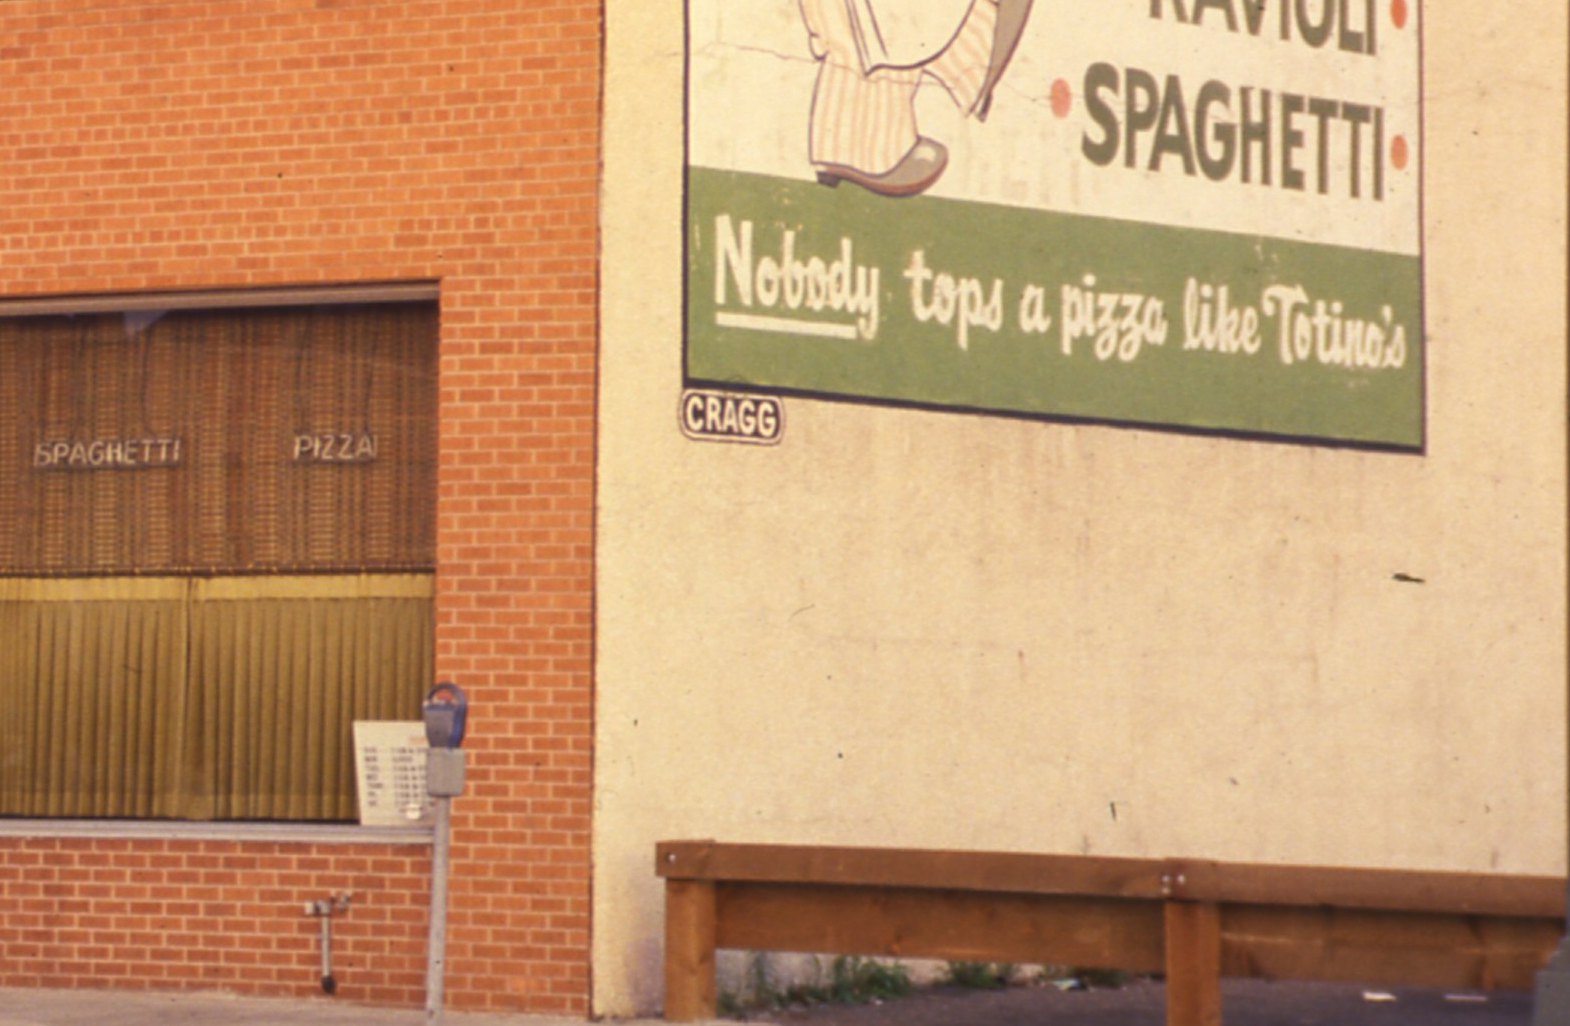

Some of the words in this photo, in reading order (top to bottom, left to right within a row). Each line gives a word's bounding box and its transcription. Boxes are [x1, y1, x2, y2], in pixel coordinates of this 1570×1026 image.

[1080, 61, 1385, 202] SPAGHETTI
[714, 213, 880, 341] Nobody
[903, 248, 1004, 350] tops
[1018, 282, 1051, 335] a
[1061, 273, 1168, 362] pizza
[1182, 277, 1262, 355] like
[1261, 283, 1407, 368] Totino's
[34, 438, 181, 468] SPAGHETTI
[293, 433, 378, 461] PIZZA
[685, 395, 778, 437] CRAGG
